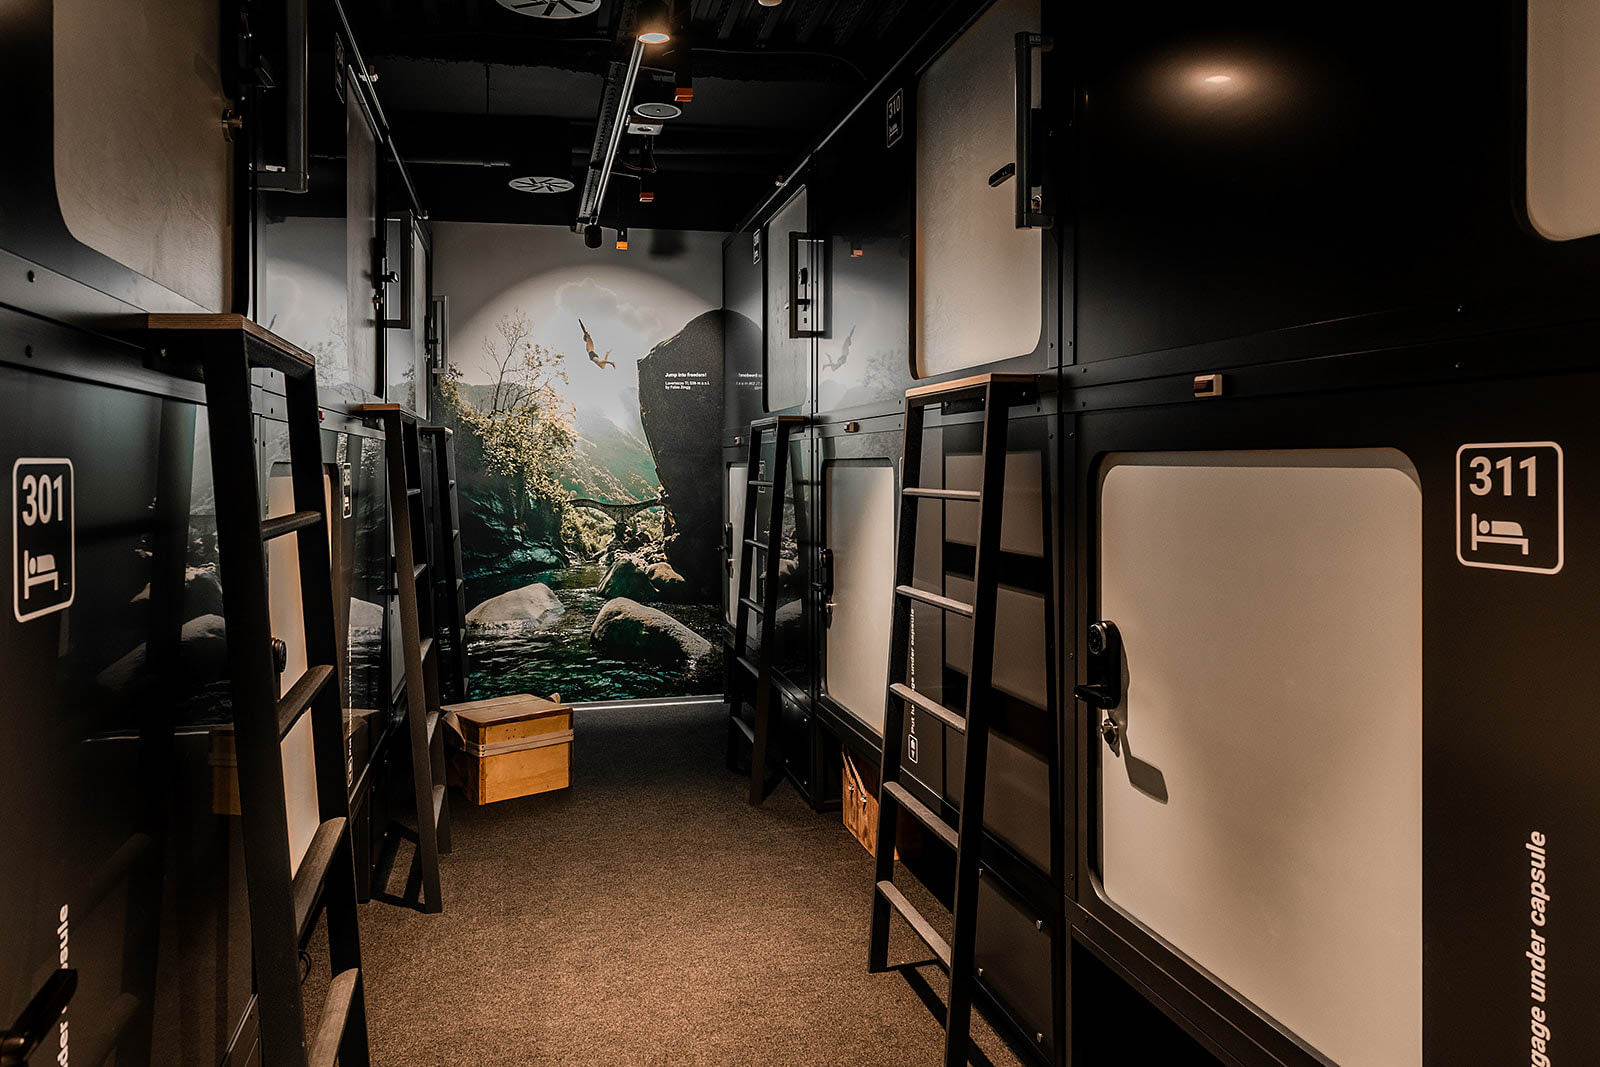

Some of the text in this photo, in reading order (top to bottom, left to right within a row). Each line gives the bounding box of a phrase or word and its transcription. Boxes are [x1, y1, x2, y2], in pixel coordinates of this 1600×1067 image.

[888, 95, 901, 119] 310
[1469, 455, 1537, 497] 311
[22, 474, 63, 527] 301
[1525, 831, 1552, 1067] gage under capsule
[57, 1021, 69, 1067] der
